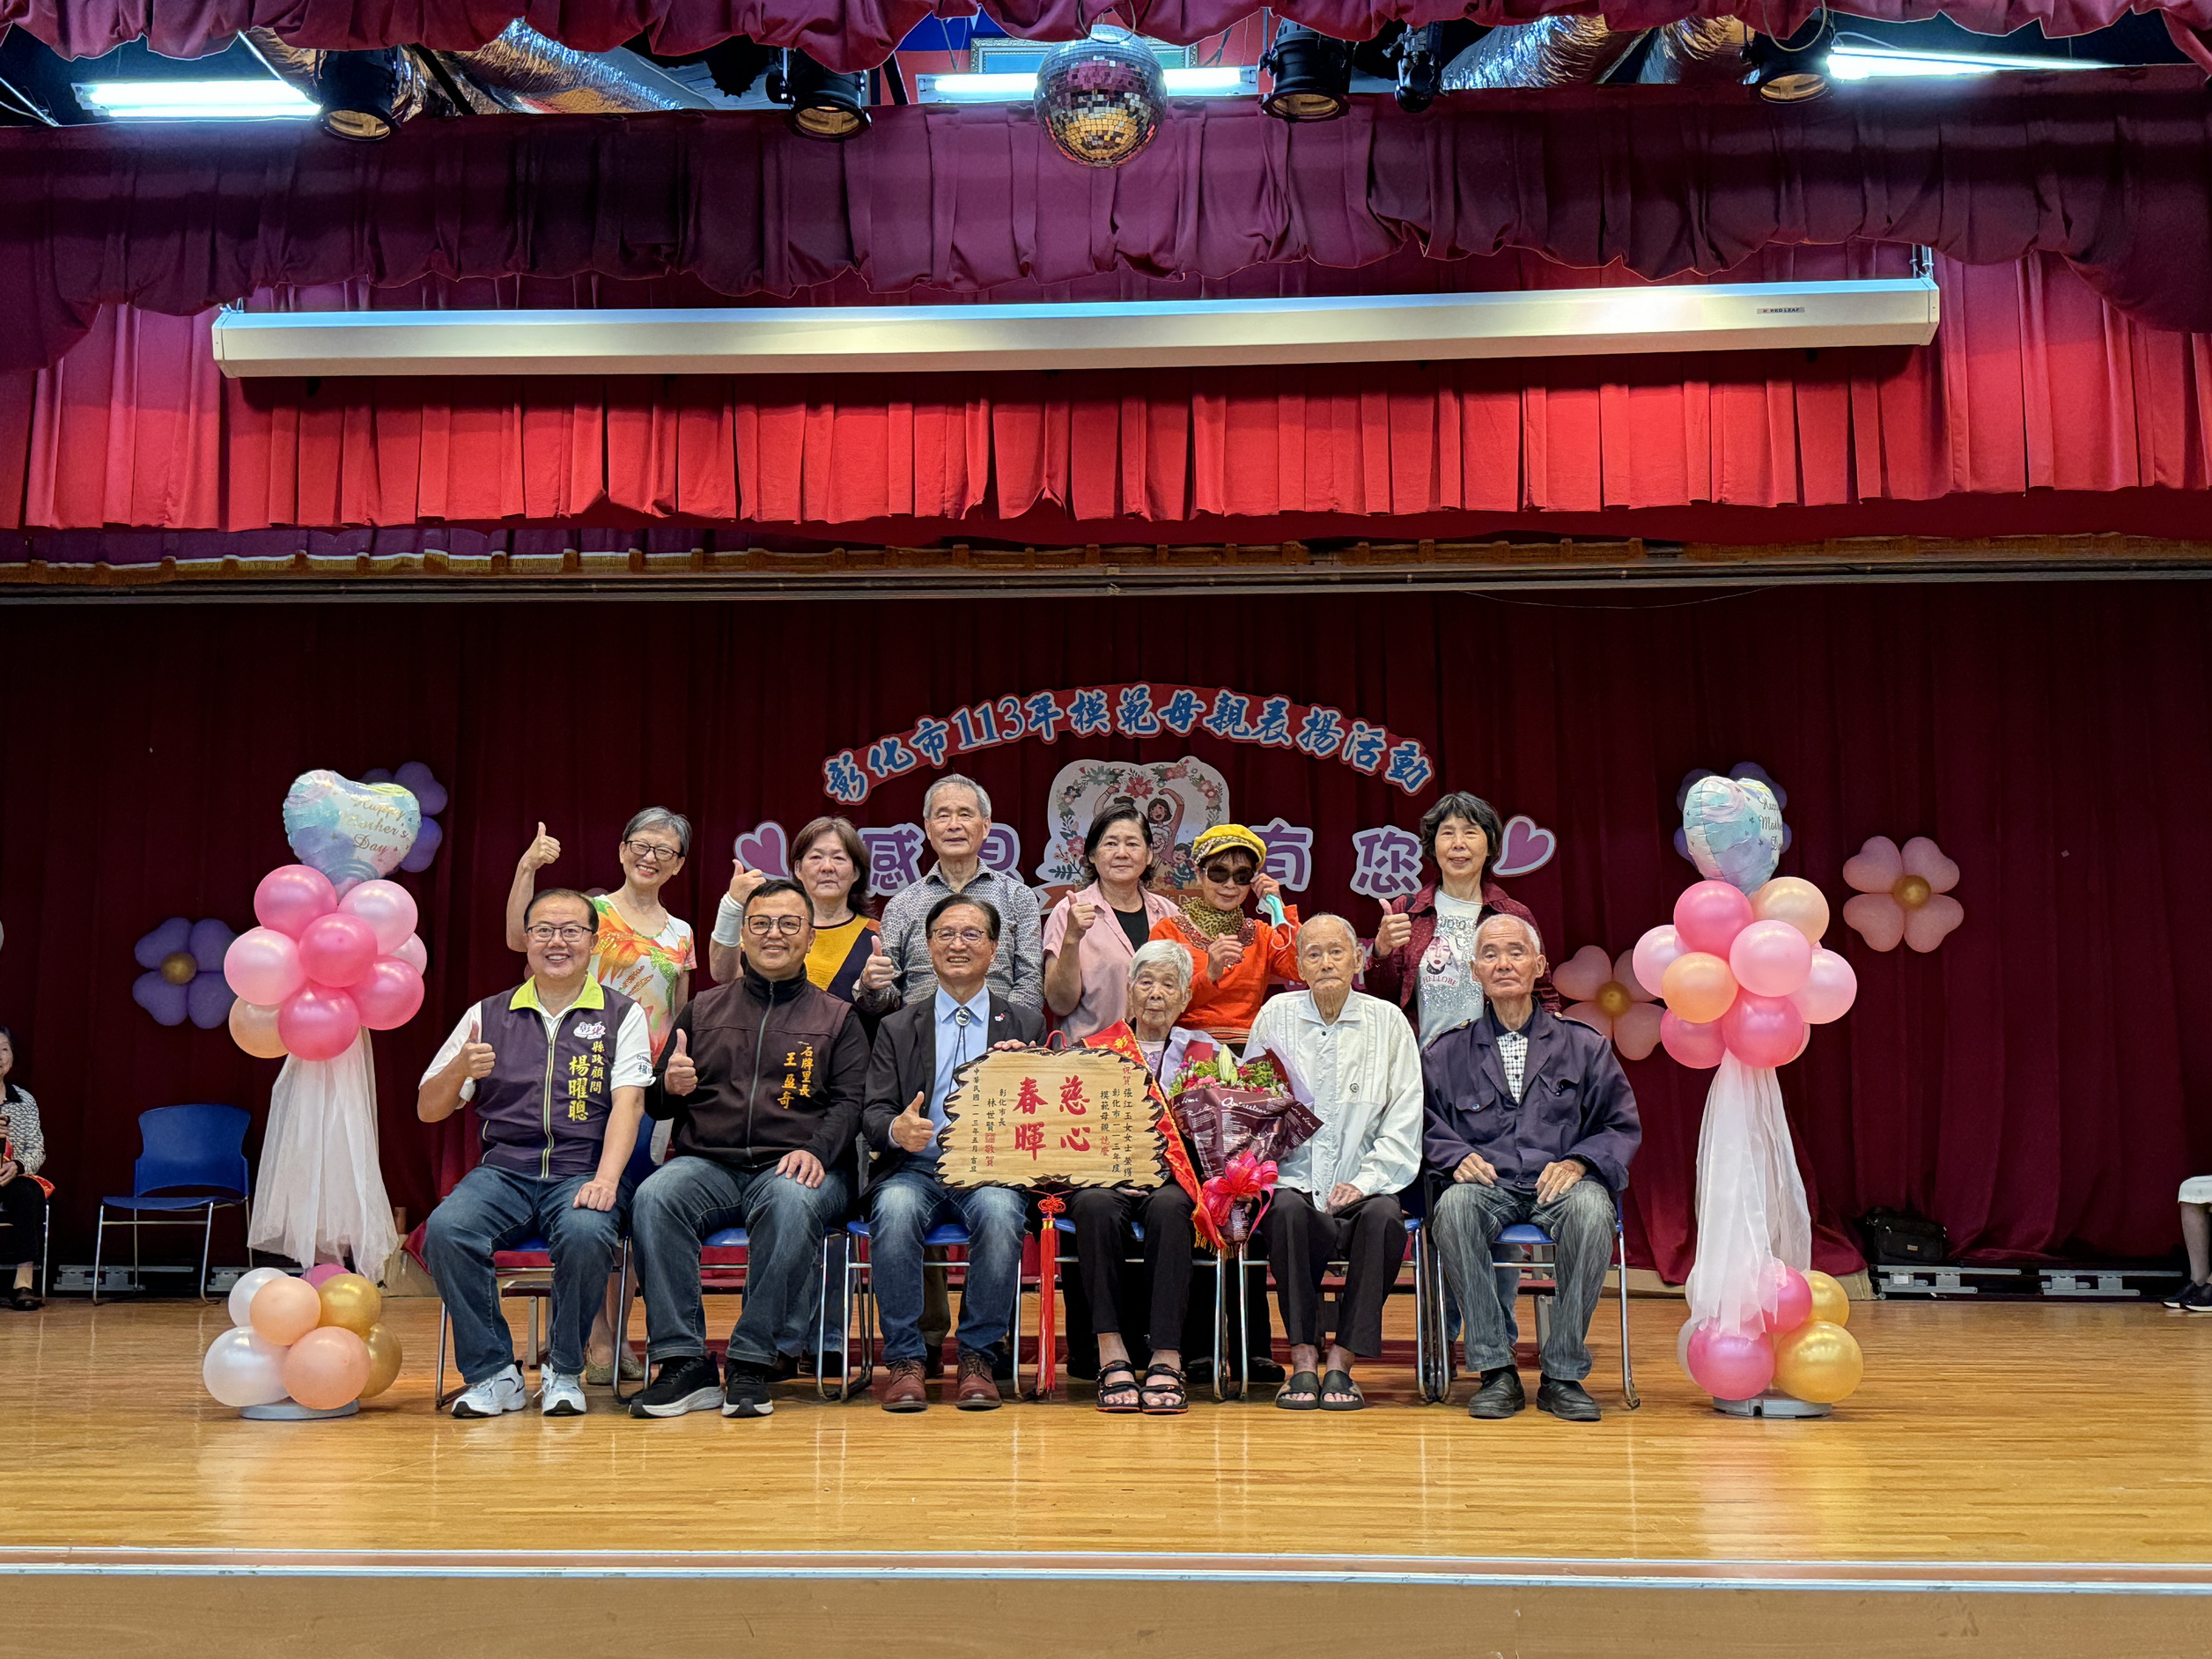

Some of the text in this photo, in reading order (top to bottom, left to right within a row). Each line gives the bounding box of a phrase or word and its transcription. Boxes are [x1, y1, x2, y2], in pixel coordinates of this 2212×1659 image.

[824, 684, 1433, 793] 彰化市113年模範母親表揚活動
[340, 811, 409, 838] Mother's
[350, 794, 406, 822] Happy
[353, 833, 388, 856] Day
[568, 1054, 591, 1122] 楊曜聰
[589, 1040, 605, 1095] 縣政顧問
[777, 1051, 797, 1110] 王盈奇
[799, 1046, 815, 1098] 石牌里長
[998, 1088, 1007, 1127] 彰化市長
[1012, 1075, 1049, 1161] 春暉
[1058, 1074, 1091, 1152] 慈心
[1112, 1088, 1121, 1173] 彰化市一一三年度
